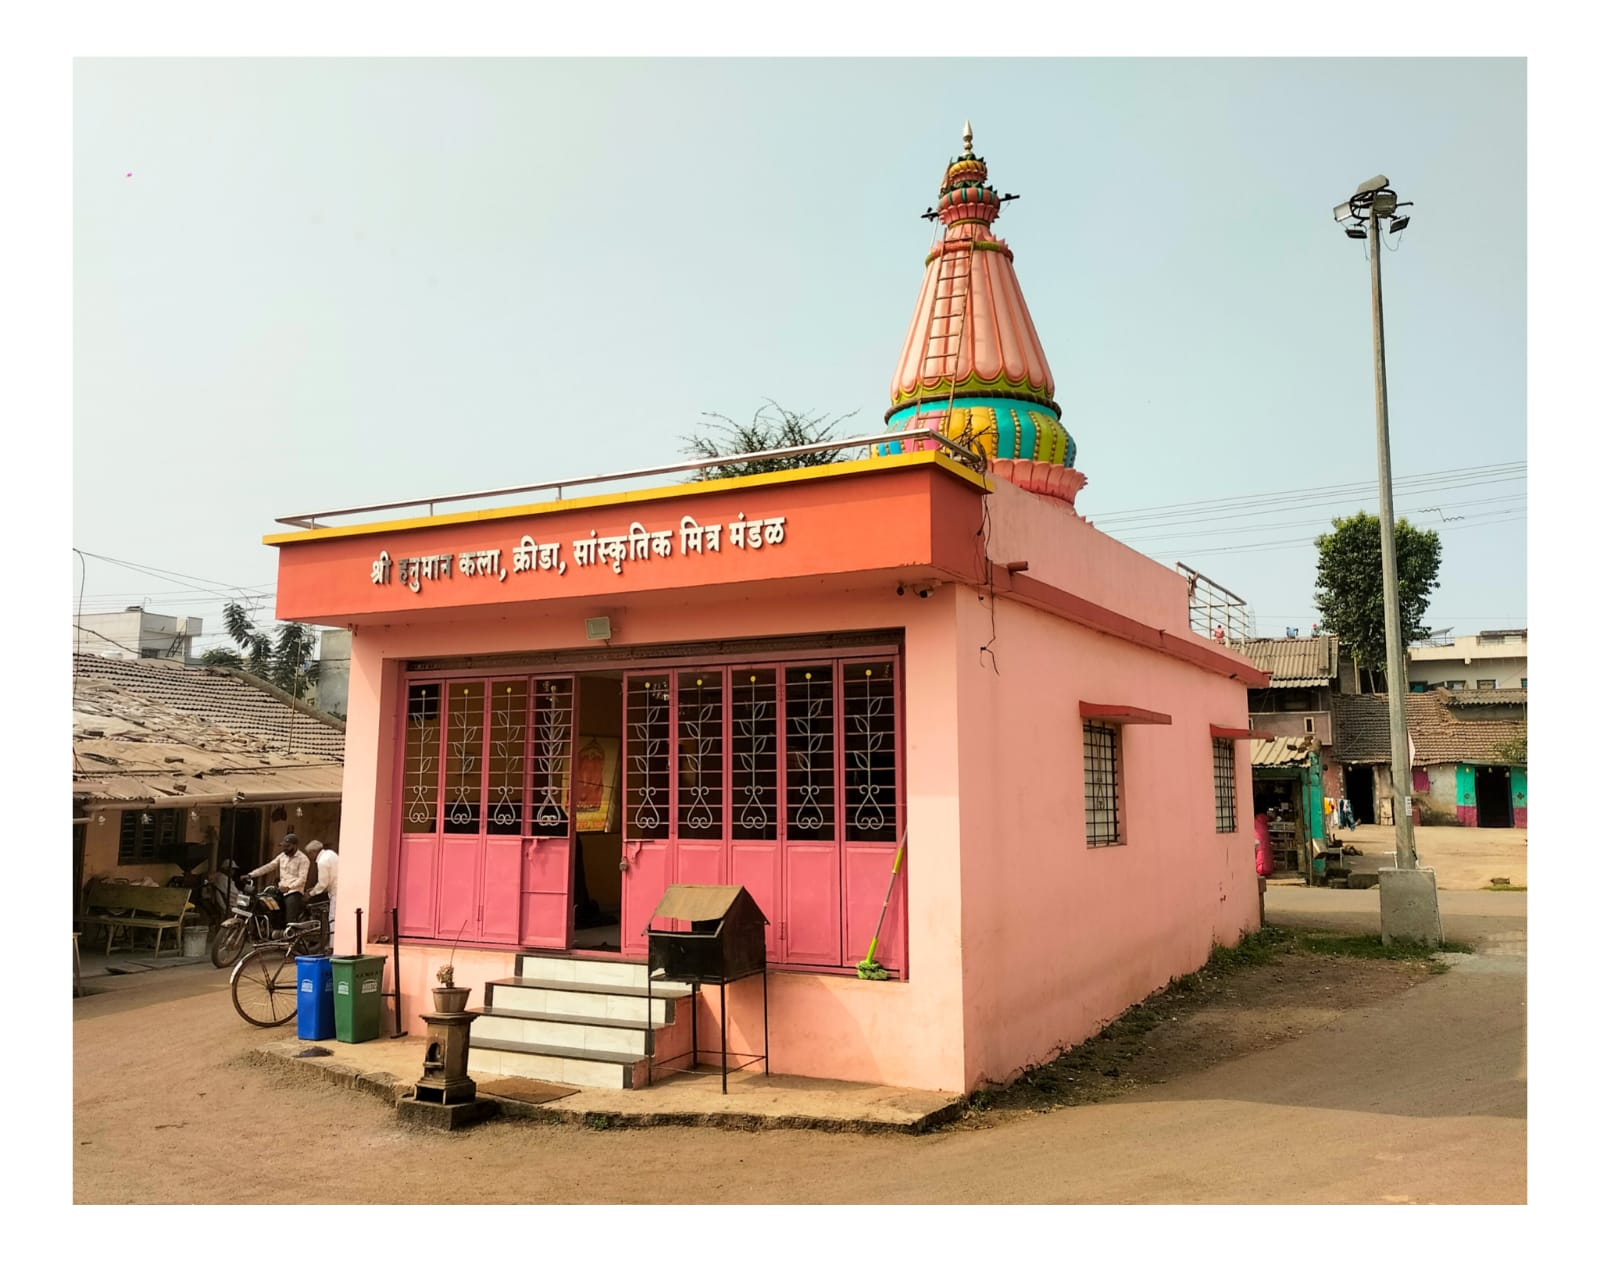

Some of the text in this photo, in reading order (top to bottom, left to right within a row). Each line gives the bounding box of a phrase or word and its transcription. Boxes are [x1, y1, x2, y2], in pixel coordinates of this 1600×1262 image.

[371, 512, 785, 592] श्री हनुमान कला, क्रीडा, सांस्कृतिक मित्र मंडळ
